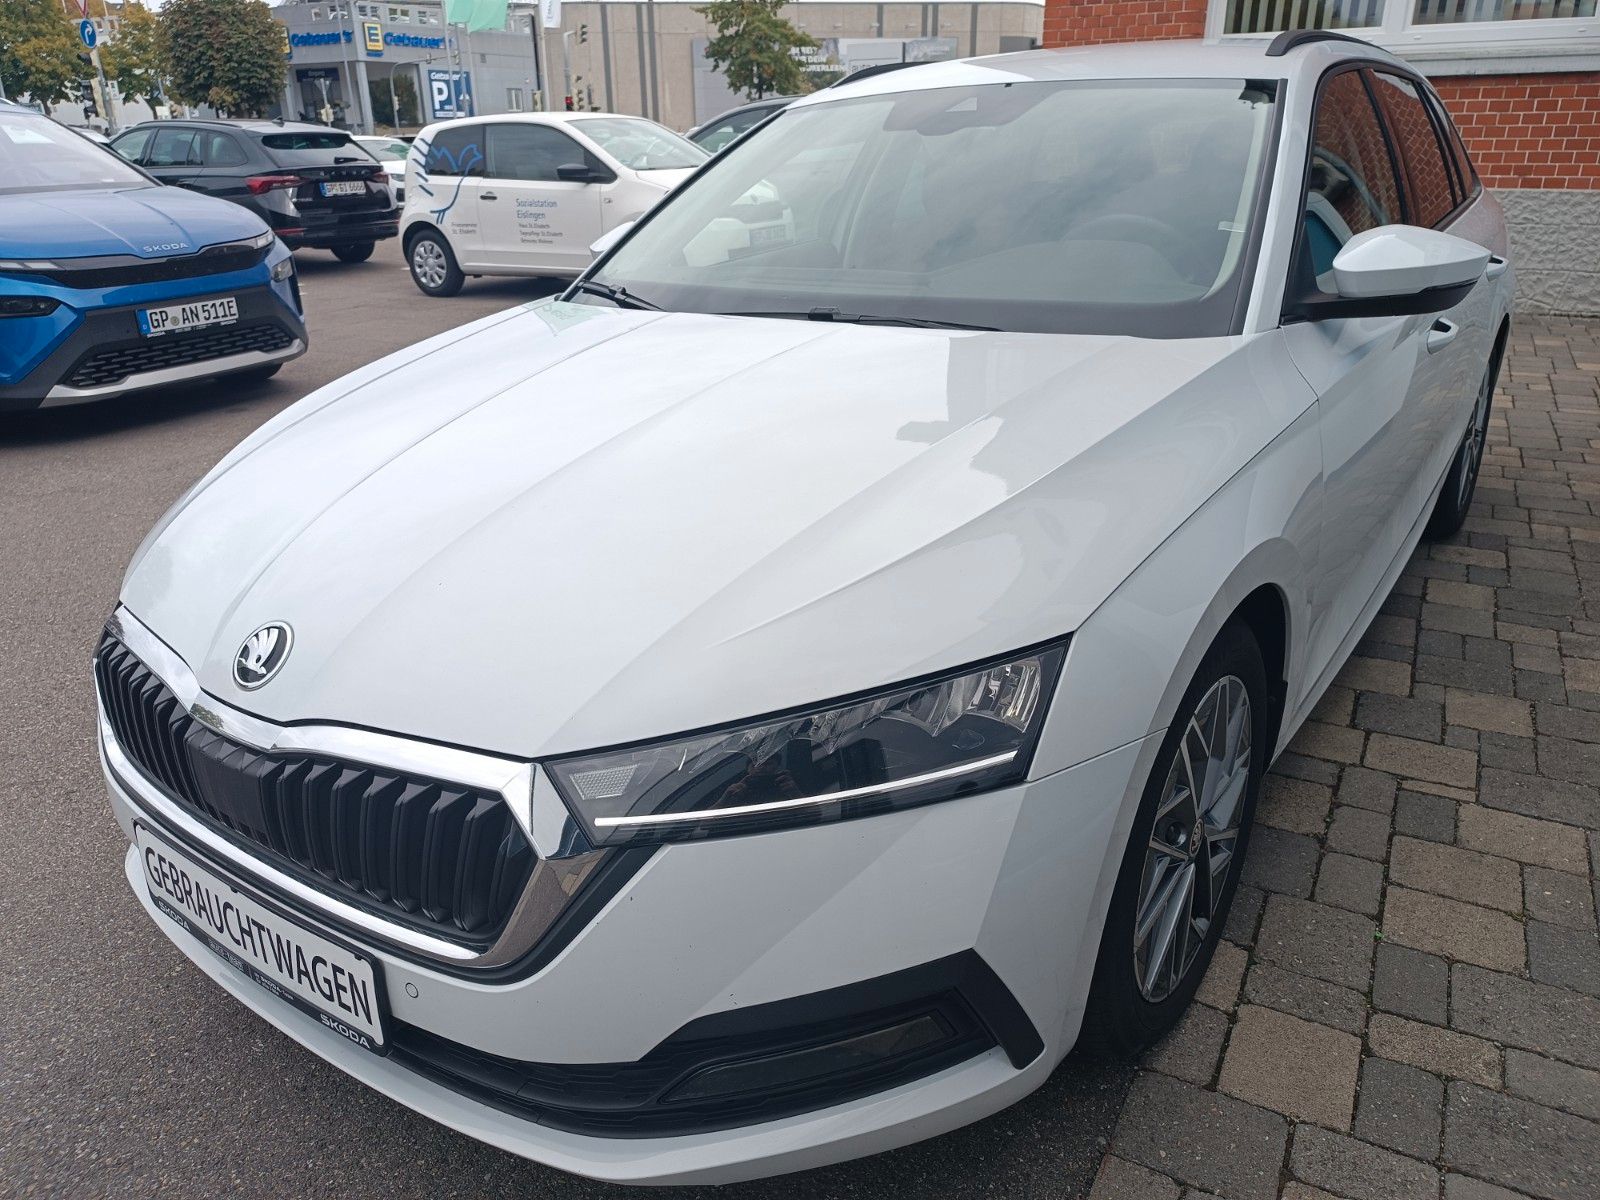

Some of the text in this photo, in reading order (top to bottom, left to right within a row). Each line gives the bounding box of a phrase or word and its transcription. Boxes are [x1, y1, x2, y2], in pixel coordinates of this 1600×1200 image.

[431, 81, 449, 110] P
[515, 198, 558, 208] Sozialstation
[149, 300, 237, 329] GP AN 511E
[144, 846, 374, 1026] GEBRAUCHTWAGEN
[320, 1013, 370, 1049] SKODA
